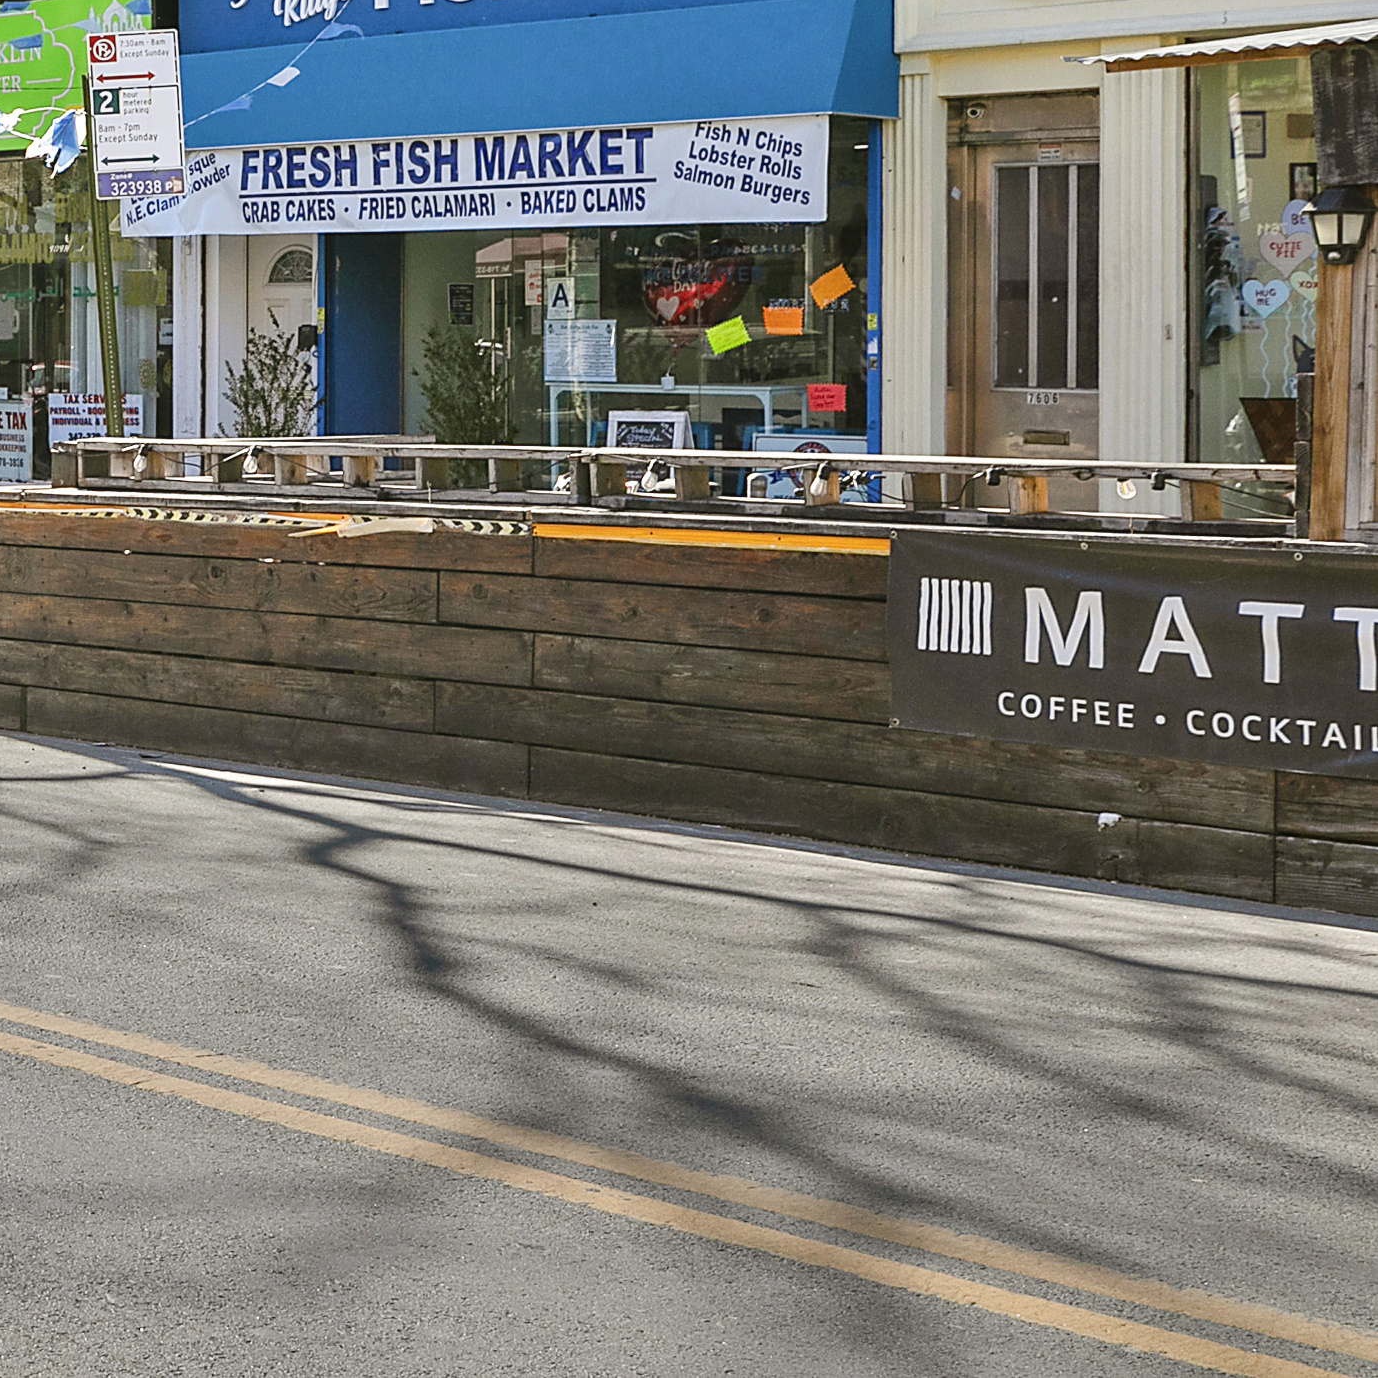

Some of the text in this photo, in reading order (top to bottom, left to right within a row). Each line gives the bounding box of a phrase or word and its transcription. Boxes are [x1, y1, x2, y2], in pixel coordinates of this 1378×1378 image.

[151, 38, 166, 46] 8am
[120, 48, 169, 58] Except Sunday
[99, 90, 138, 113] 2 hour
[123, 97, 152, 107] metered
[123, 106, 149, 115] parking
[98, 124, 115, 133] 8am
[124, 123, 141, 133] 7pm
[98, 132, 158, 144] Except Sunday
[695, 121, 803, 159] Fish N Chips
[188, 152, 217, 176] sque
[240, 127, 654, 191] FRESH FISH MARKET
[688, 140, 802, 180] Lobster Rolls
[185, 164, 231, 199] owder
[673, 160, 811, 205] Salmon Burgers
[110, 181, 163, 197] 323938
[242, 186, 646, 223] CRAB CAKES FRIED CALAMARI BAKED CLAMS
[1269, 241, 1302, 251] CUTIE
[1276, 250, 1296, 258] PIE
[551, 282, 569, 308] A
[1255, 288, 1277, 297] HUG
[1256, 297, 1270, 306] ME
[63, 394, 79, 404] TAX
[1028, 392, 1058, 405] 7606
[50, 407, 80, 415] PAYROLL
[5, 411, 27, 430] TAX
[1025, 586, 1378, 692] MATT
[997, 691, 1378, 753] COFFEE COCKTAIL
